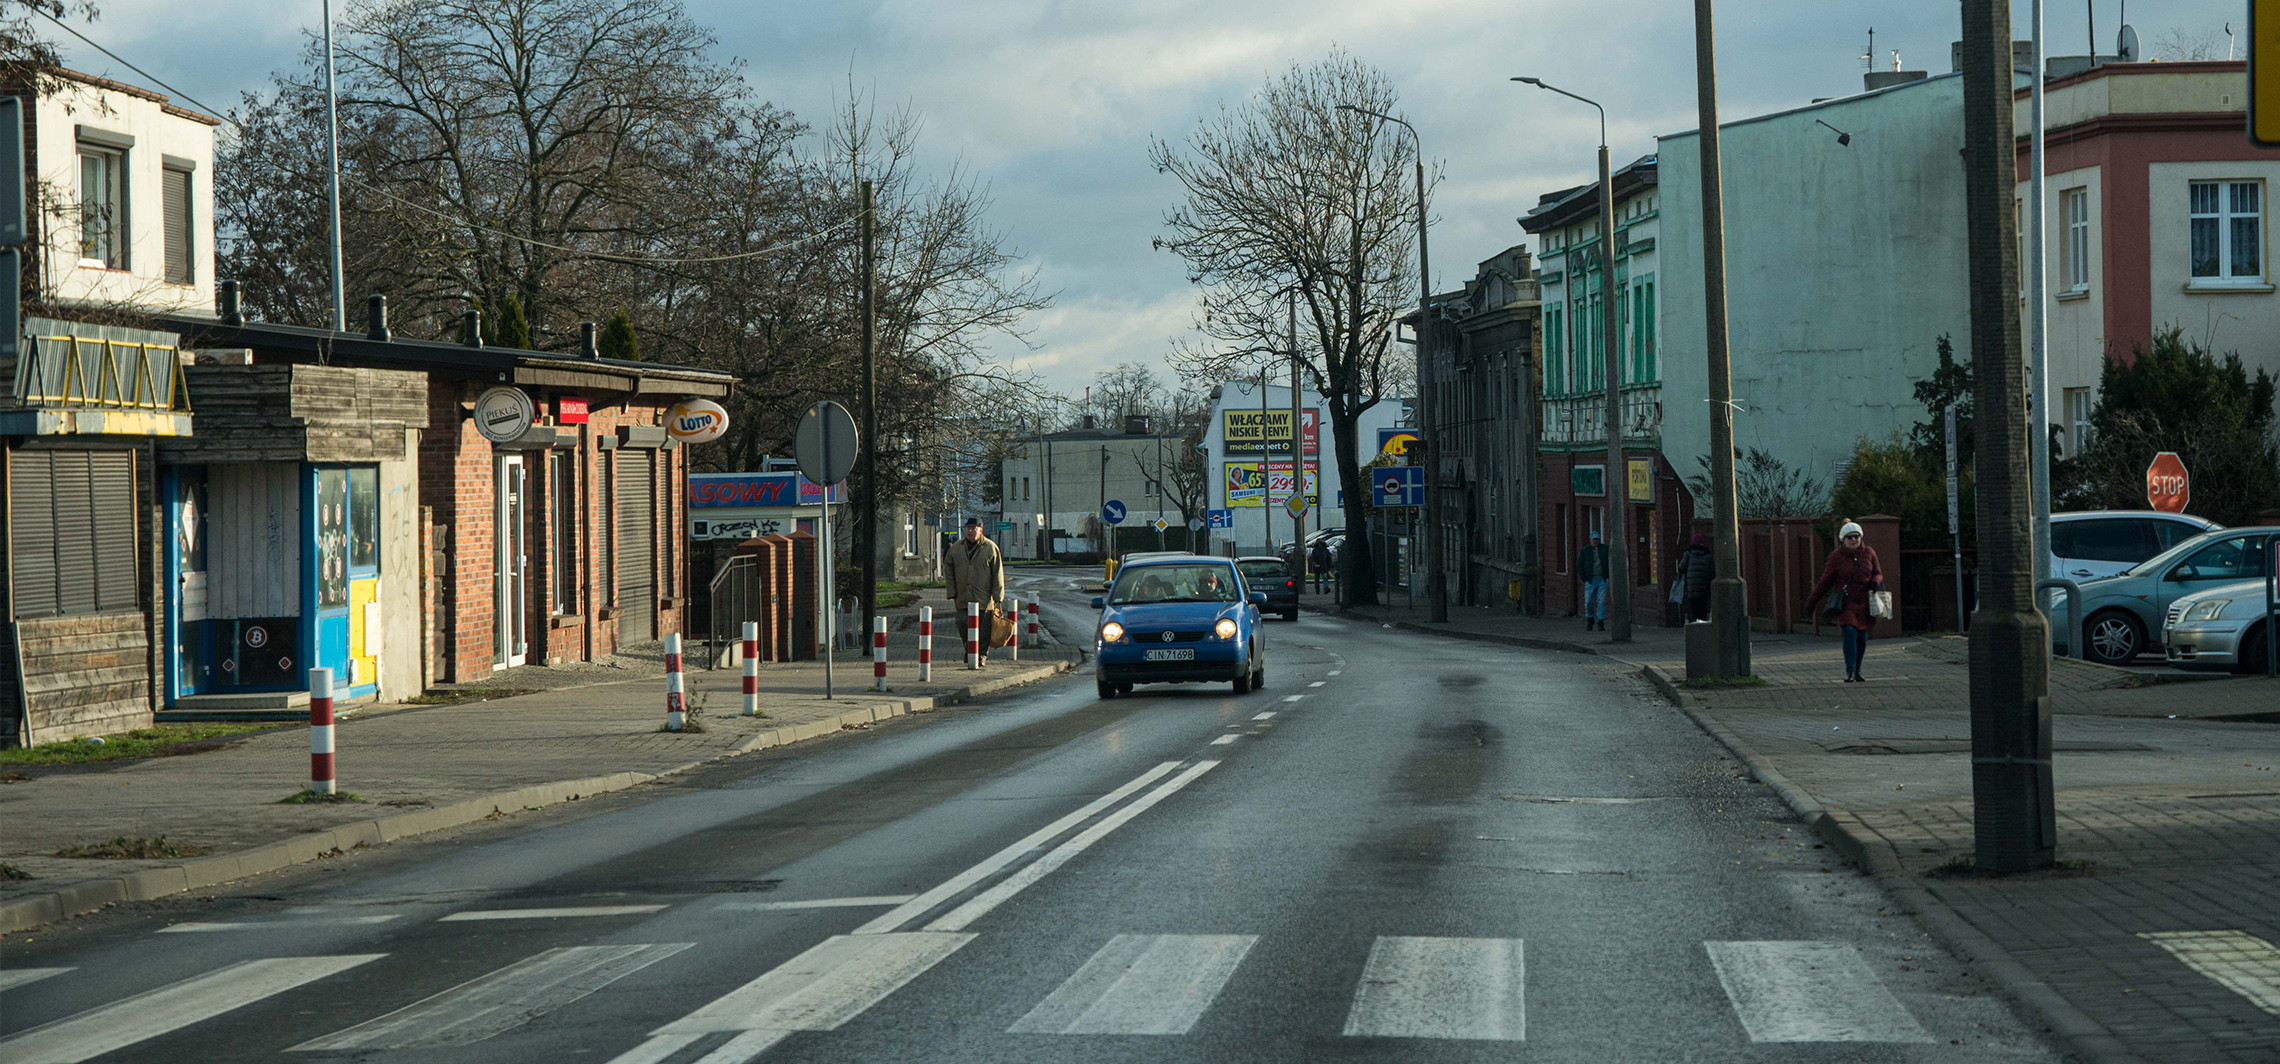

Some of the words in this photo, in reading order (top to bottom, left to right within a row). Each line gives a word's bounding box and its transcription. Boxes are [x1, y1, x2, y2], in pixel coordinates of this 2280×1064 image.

[486, 403, 518, 419] PIEKUŚ
[680, 415, 712, 431] LOTTO
[1229, 427, 1259, 437] NISKIE
[1262, 426, 1289, 437] ENY!
[1230, 443, 1281, 451] mediaexert
[2152, 475, 2185, 495] STOP
[1231, 489, 1256, 498] SAMSUNG
[1147, 650, 1164, 660] CIN
[1166, 650, 1193, 660] 71698
